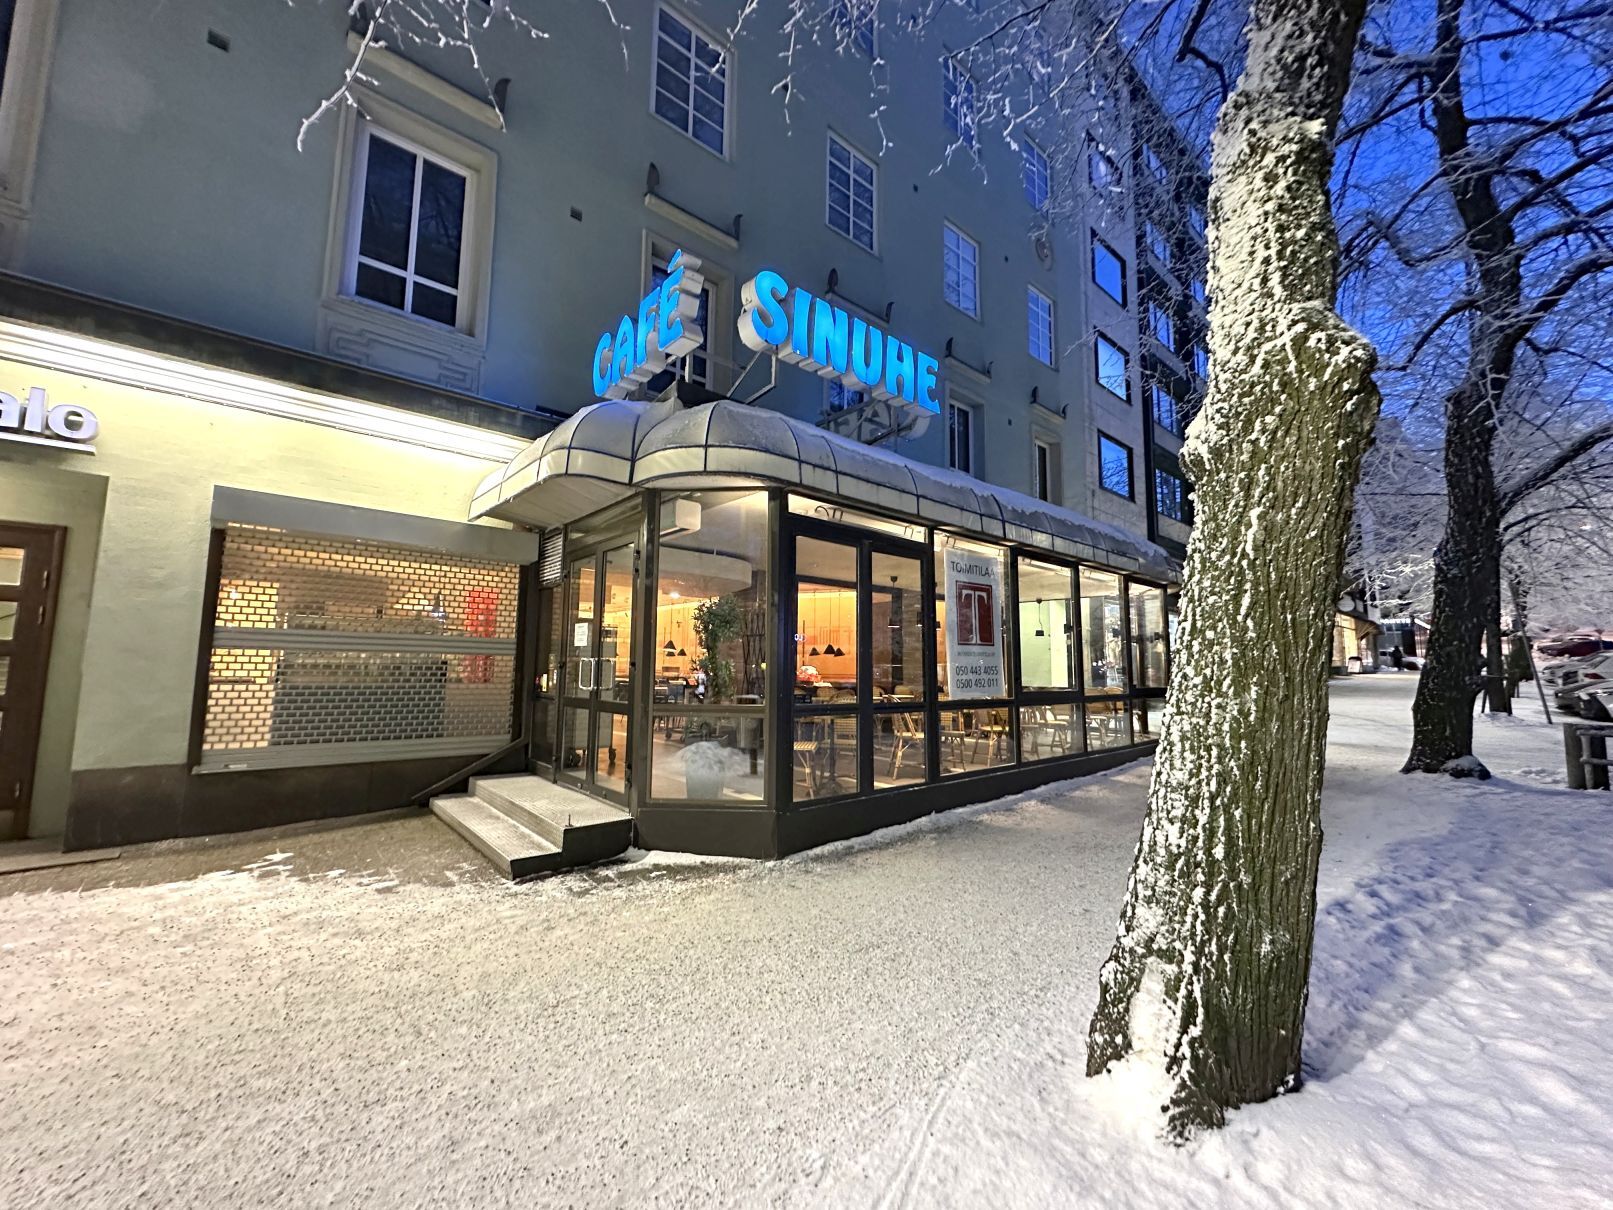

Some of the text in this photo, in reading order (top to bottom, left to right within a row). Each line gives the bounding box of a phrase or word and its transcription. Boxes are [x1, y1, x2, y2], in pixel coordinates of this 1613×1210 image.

[593, 249, 941, 414] CAFÉ SINUHE
[955, 665, 999, 676] 050 443 4055
[956, 677, 998, 689] 0500 492 011
